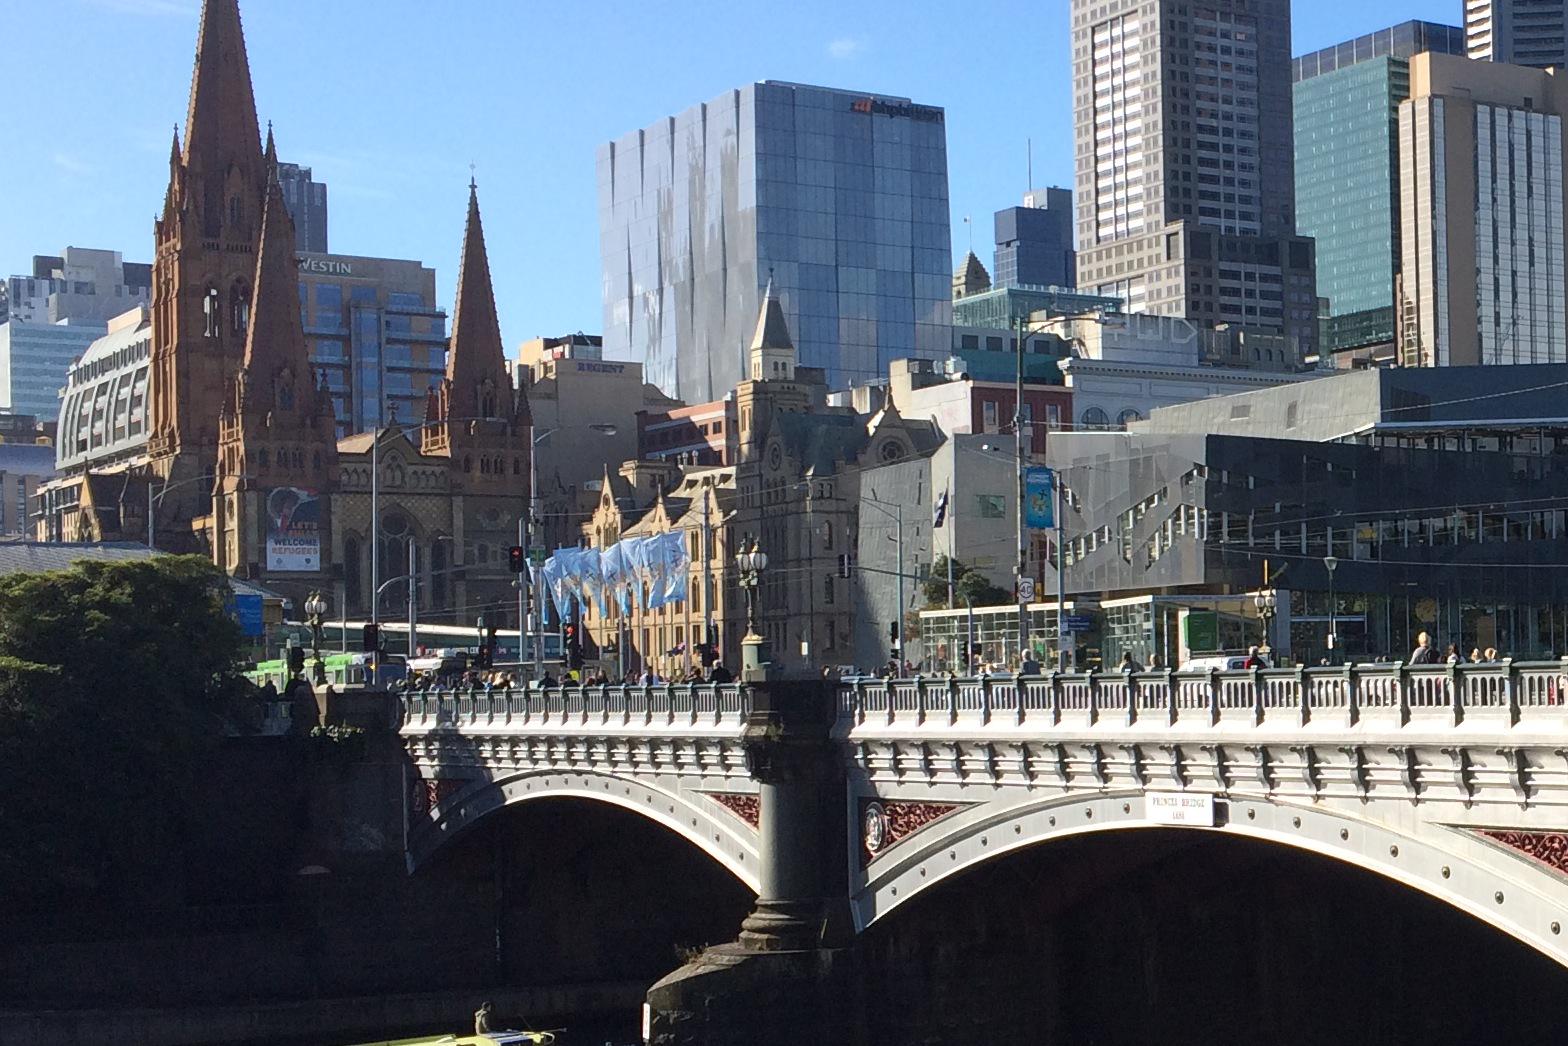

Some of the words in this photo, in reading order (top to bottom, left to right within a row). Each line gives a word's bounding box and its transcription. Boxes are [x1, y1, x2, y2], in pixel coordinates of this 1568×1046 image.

[577, 362, 625, 374] REGENT
[273, 538, 318, 547] WELCOME
[271, 547, 319, 556] REFUGEES
[1181, 798, 1205, 808] BRIDGE
